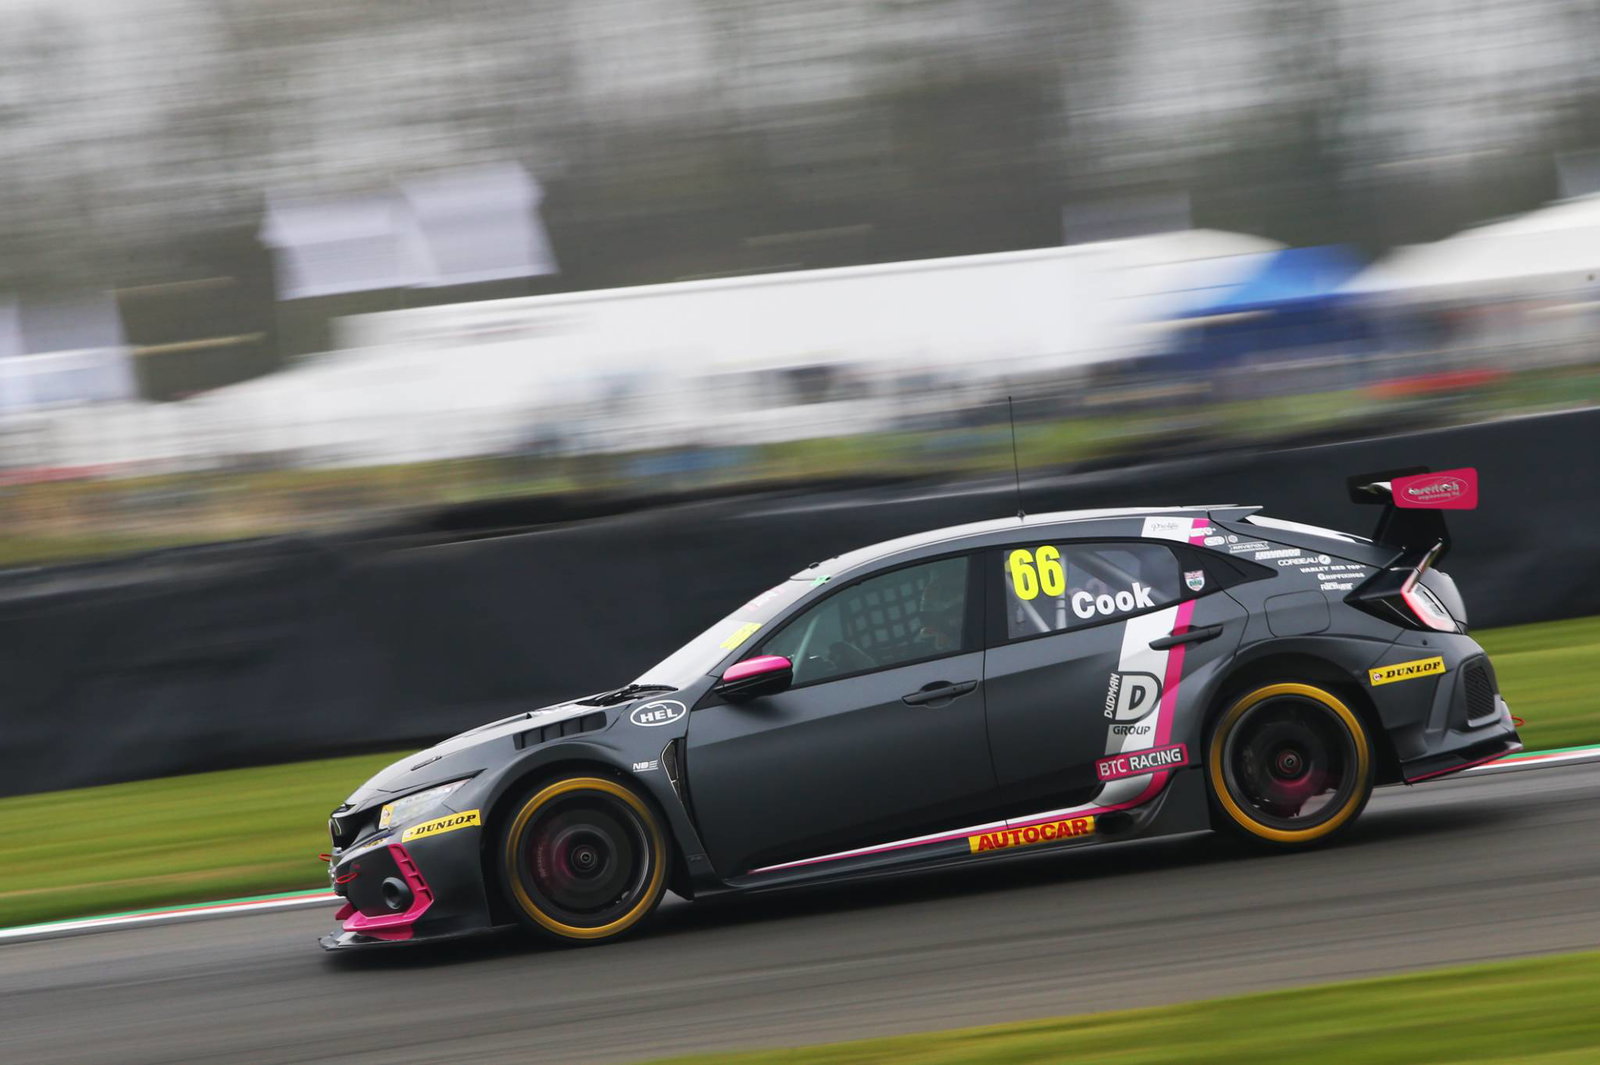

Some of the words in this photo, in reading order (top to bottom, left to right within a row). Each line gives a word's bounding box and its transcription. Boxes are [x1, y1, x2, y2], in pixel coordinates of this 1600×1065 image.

[1008, 545, 1066, 601] 66
[1277, 557, 1319, 567] CORBEAU
[1071, 582, 1156, 619] Cook
[1386, 661, 1441, 679] DUNLOP
[1103, 672, 1120, 719] DUDMAN
[640, 708, 678, 723] HEL
[1113, 725, 1151, 736] GROUP
[1099, 758, 1127, 777] BTC
[1129, 747, 1182, 771] RACING
[415, 814, 477, 835] DUNLOP
[978, 818, 1088, 851] AUTOCAR
